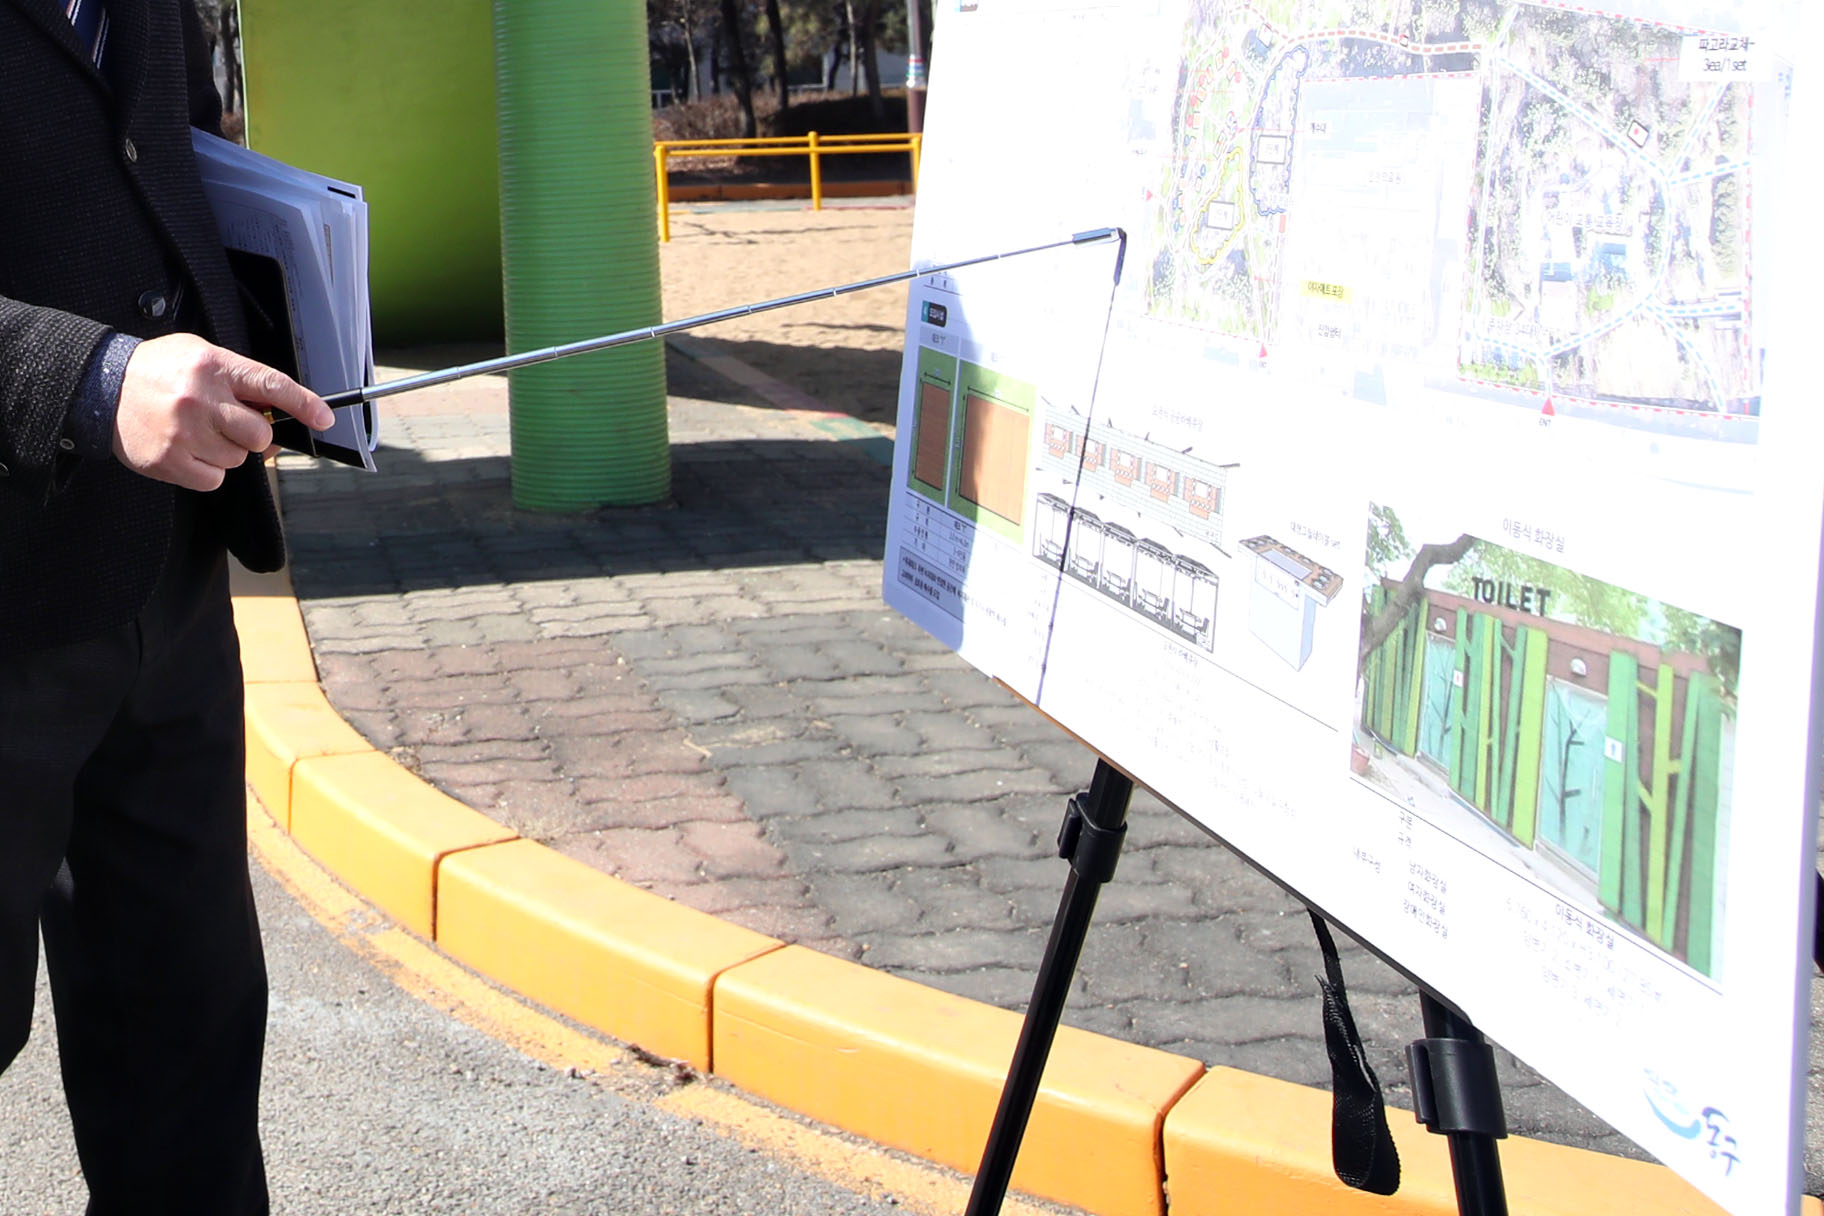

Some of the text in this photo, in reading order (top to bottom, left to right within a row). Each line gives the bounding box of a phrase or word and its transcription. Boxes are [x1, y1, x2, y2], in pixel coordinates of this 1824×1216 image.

[1502, 518, 1565, 553] 이동식 화장실
[1471, 576, 1552, 617] TOILET
[1555, 903, 1583, 929] 이동식
[1585, 920, 1615, 951] 화장실
